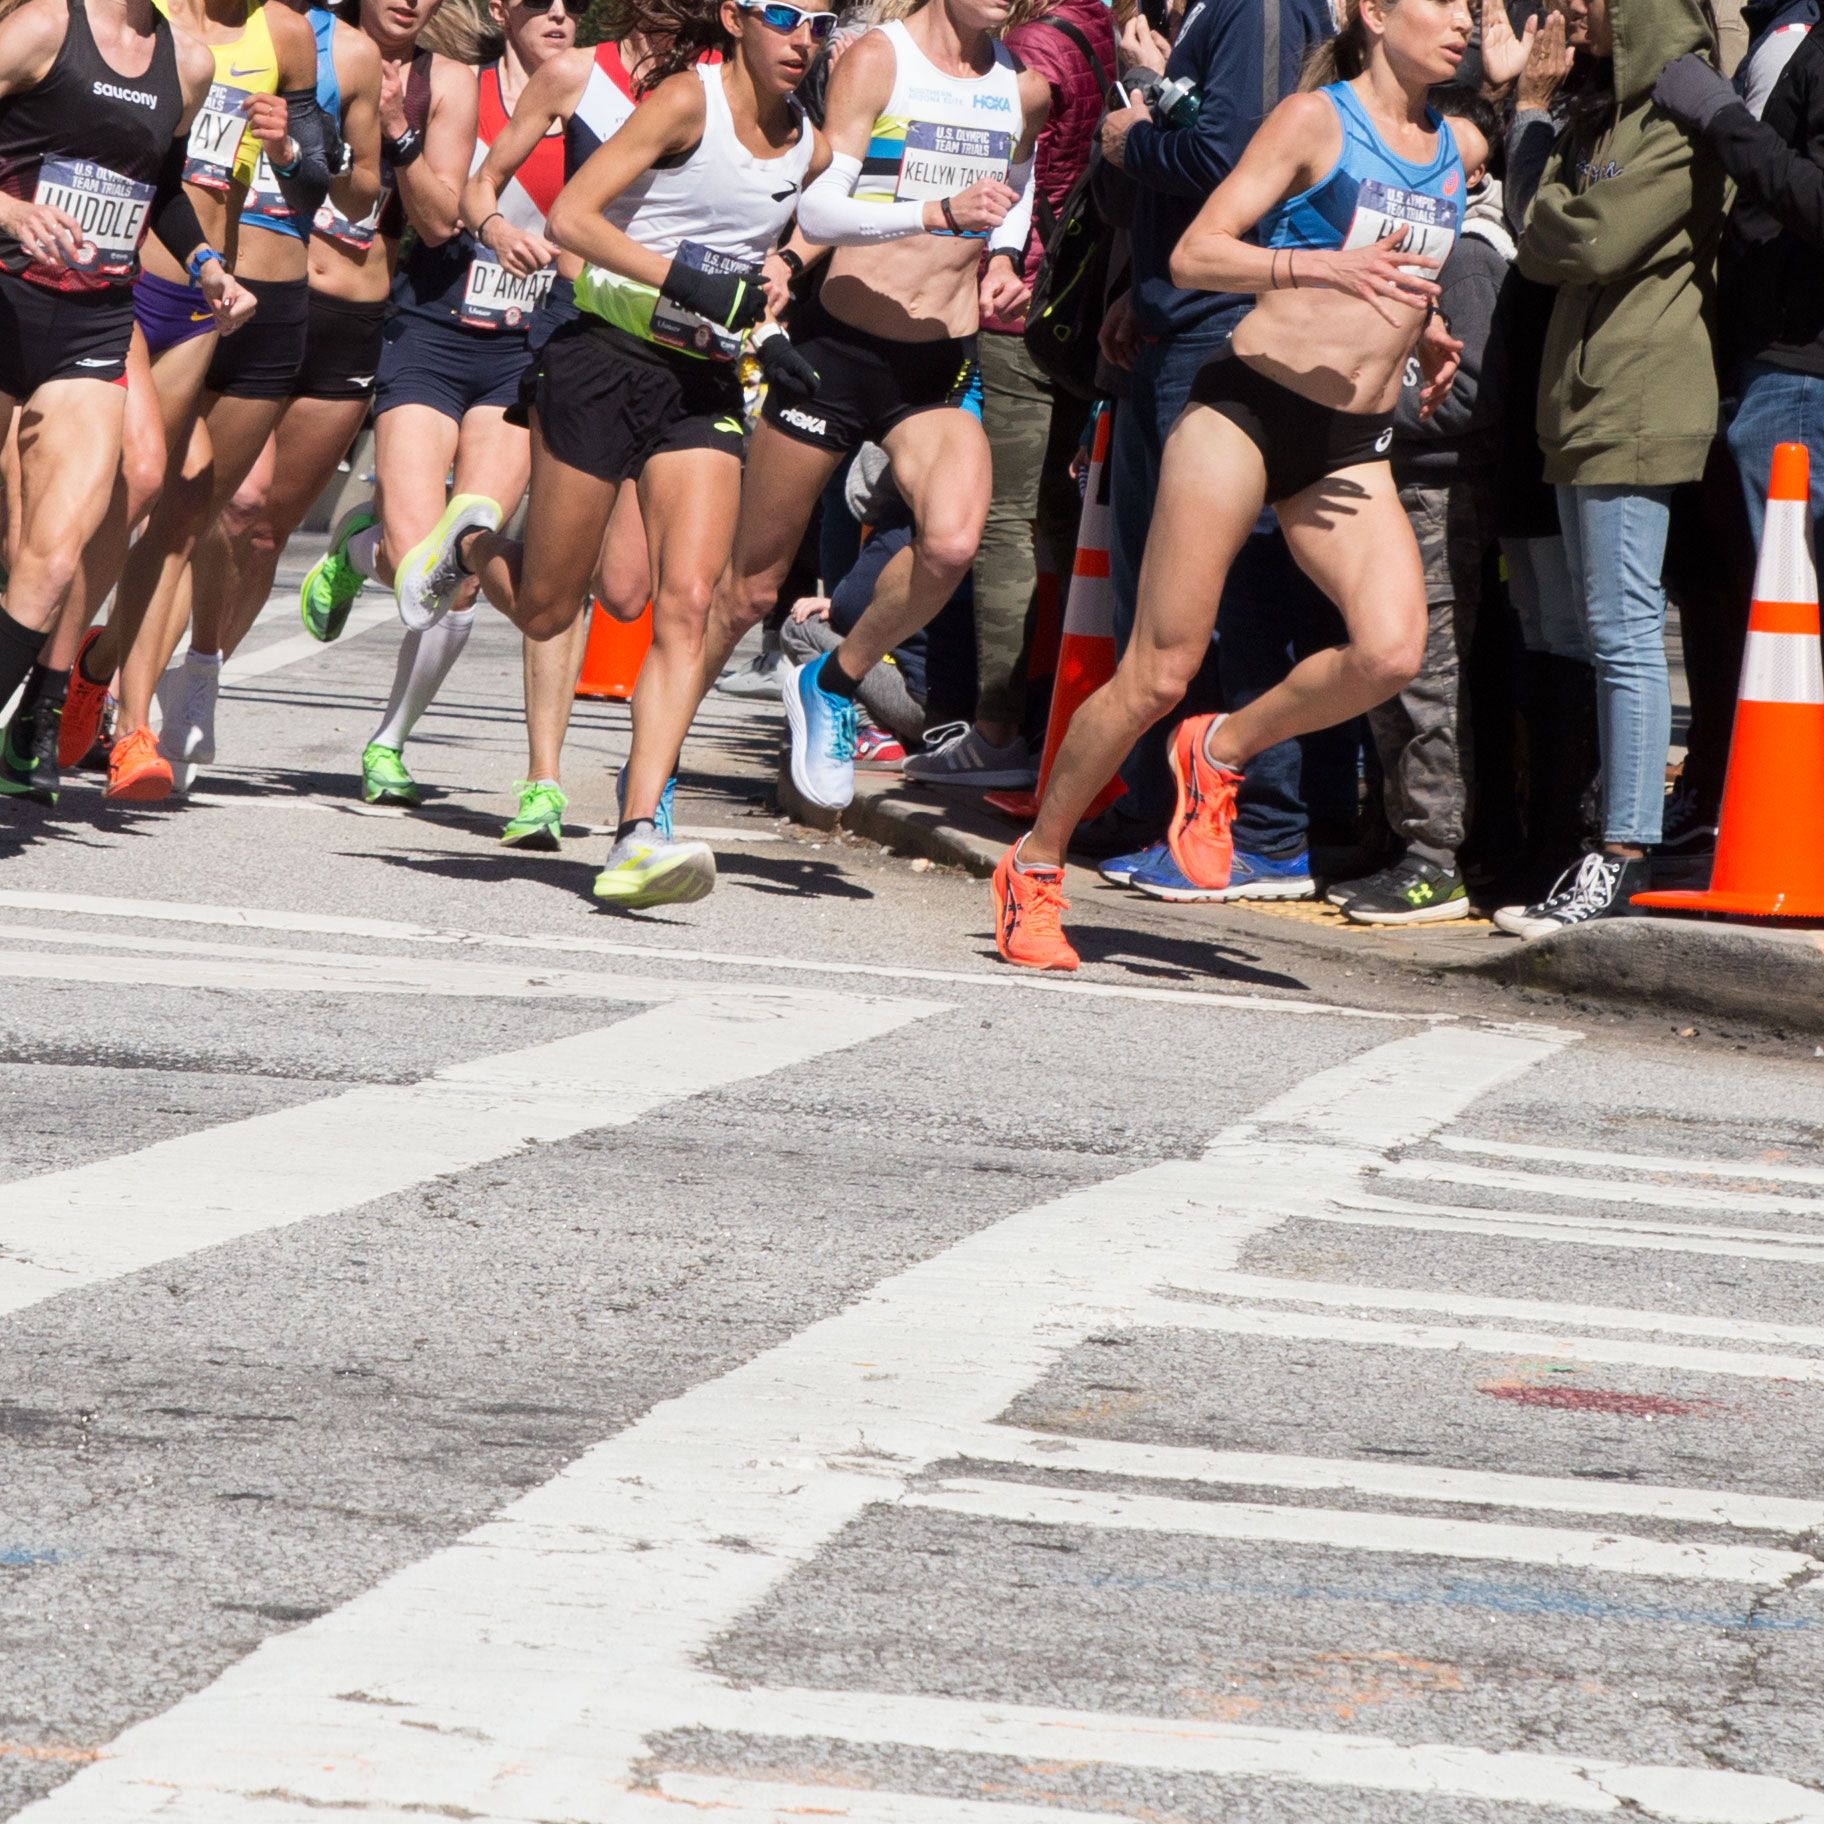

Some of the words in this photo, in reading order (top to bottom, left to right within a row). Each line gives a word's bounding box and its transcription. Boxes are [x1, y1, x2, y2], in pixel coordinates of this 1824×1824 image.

[92, 80, 158, 110] saucony
[972, 94, 1012, 113] HOKA
[936, 126, 954, 140] U.S.
[955, 129, 990, 144] OLYMPIC
[934, 139, 960, 153] TEAM
[961, 141, 990, 156] TRIALS
[74, 162, 94, 178] U.S.
[904, 161, 956, 186] KELLYN
[72, 175, 100, 193] TEAM
[101, 181, 134, 198] TRIALS
[1386, 188, 1404, 203] U.S.
[1406, 207, 1436, 224] TRIALS
[703, 250, 720, 266] U.S.
[472, 265, 552, 303] D'AMAT
